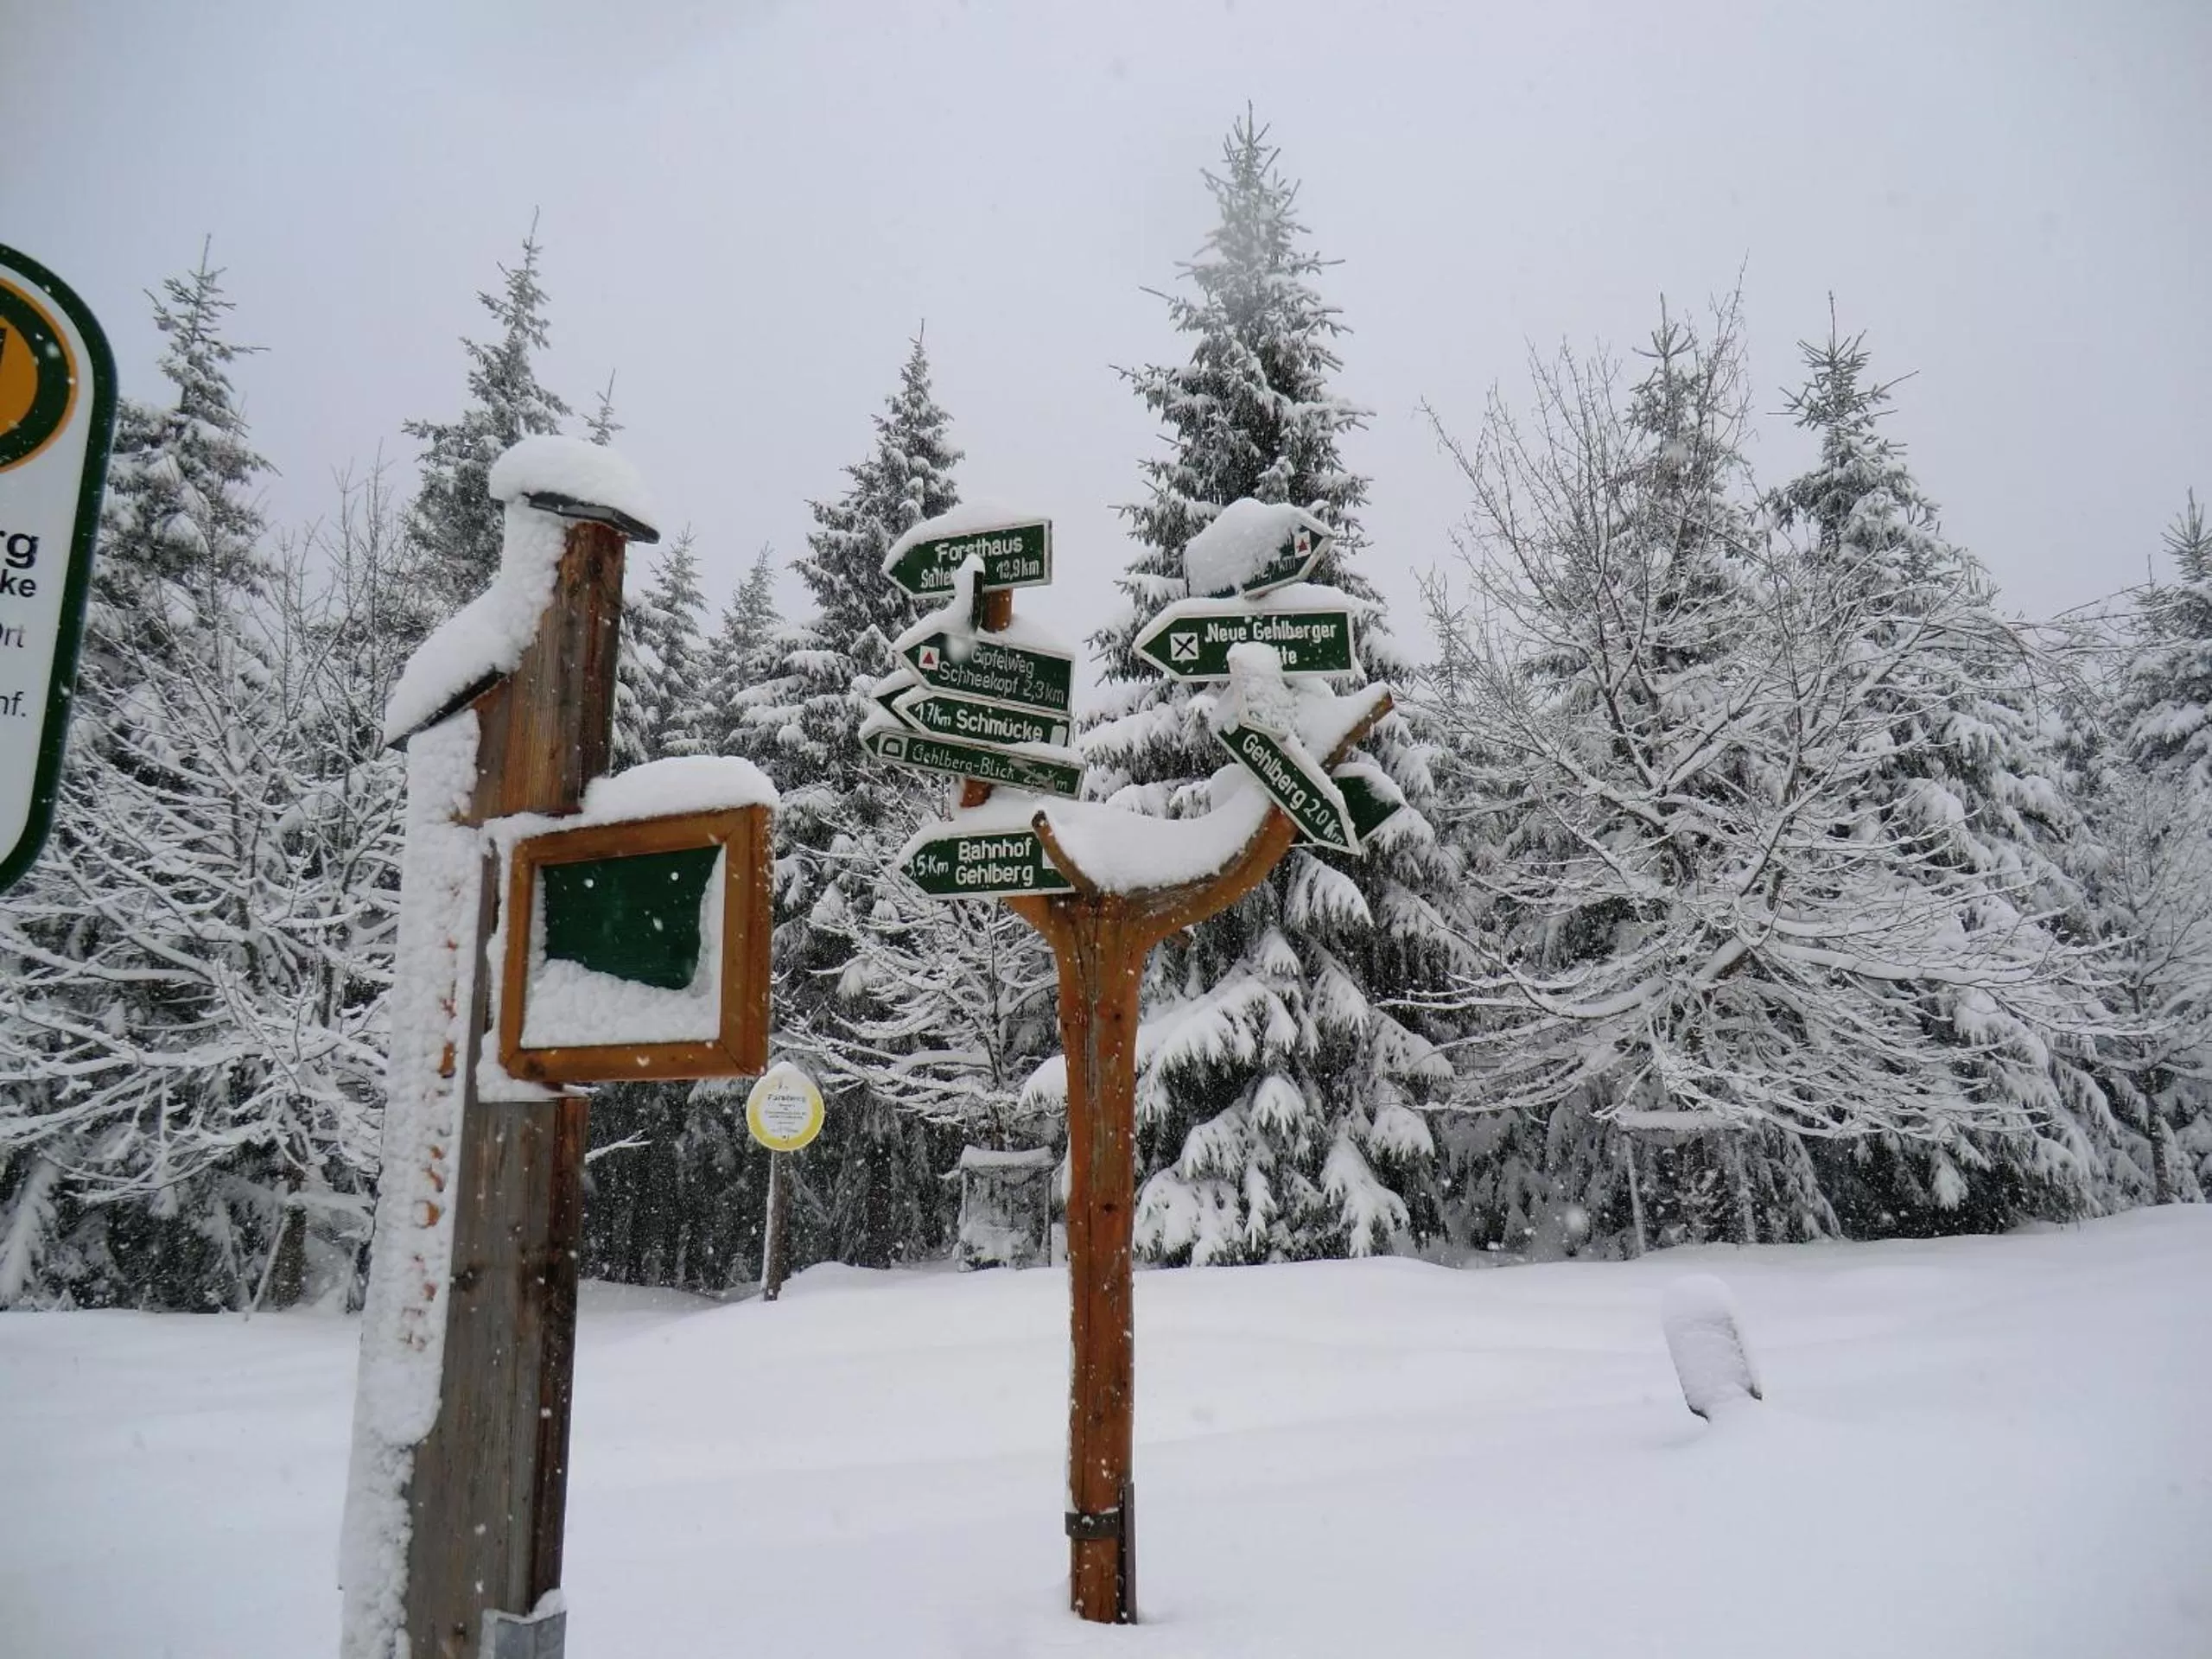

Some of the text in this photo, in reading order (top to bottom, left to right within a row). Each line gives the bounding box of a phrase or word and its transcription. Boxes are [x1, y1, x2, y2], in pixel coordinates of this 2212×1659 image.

[935, 537, 1022, 563] Forsthaus
[1206, 617, 1337, 644] Neue Gehlberger
[971, 647, 1034, 678] Gipfelweg
[939, 661, 1018, 696] Schneekopf
[956, 709, 1043, 741] Schmücke
[1243, 734, 1306, 810] Gehlberg
[958, 837, 1033, 861] Bahnhof
[956, 863, 1034, 887] Gehlberg
